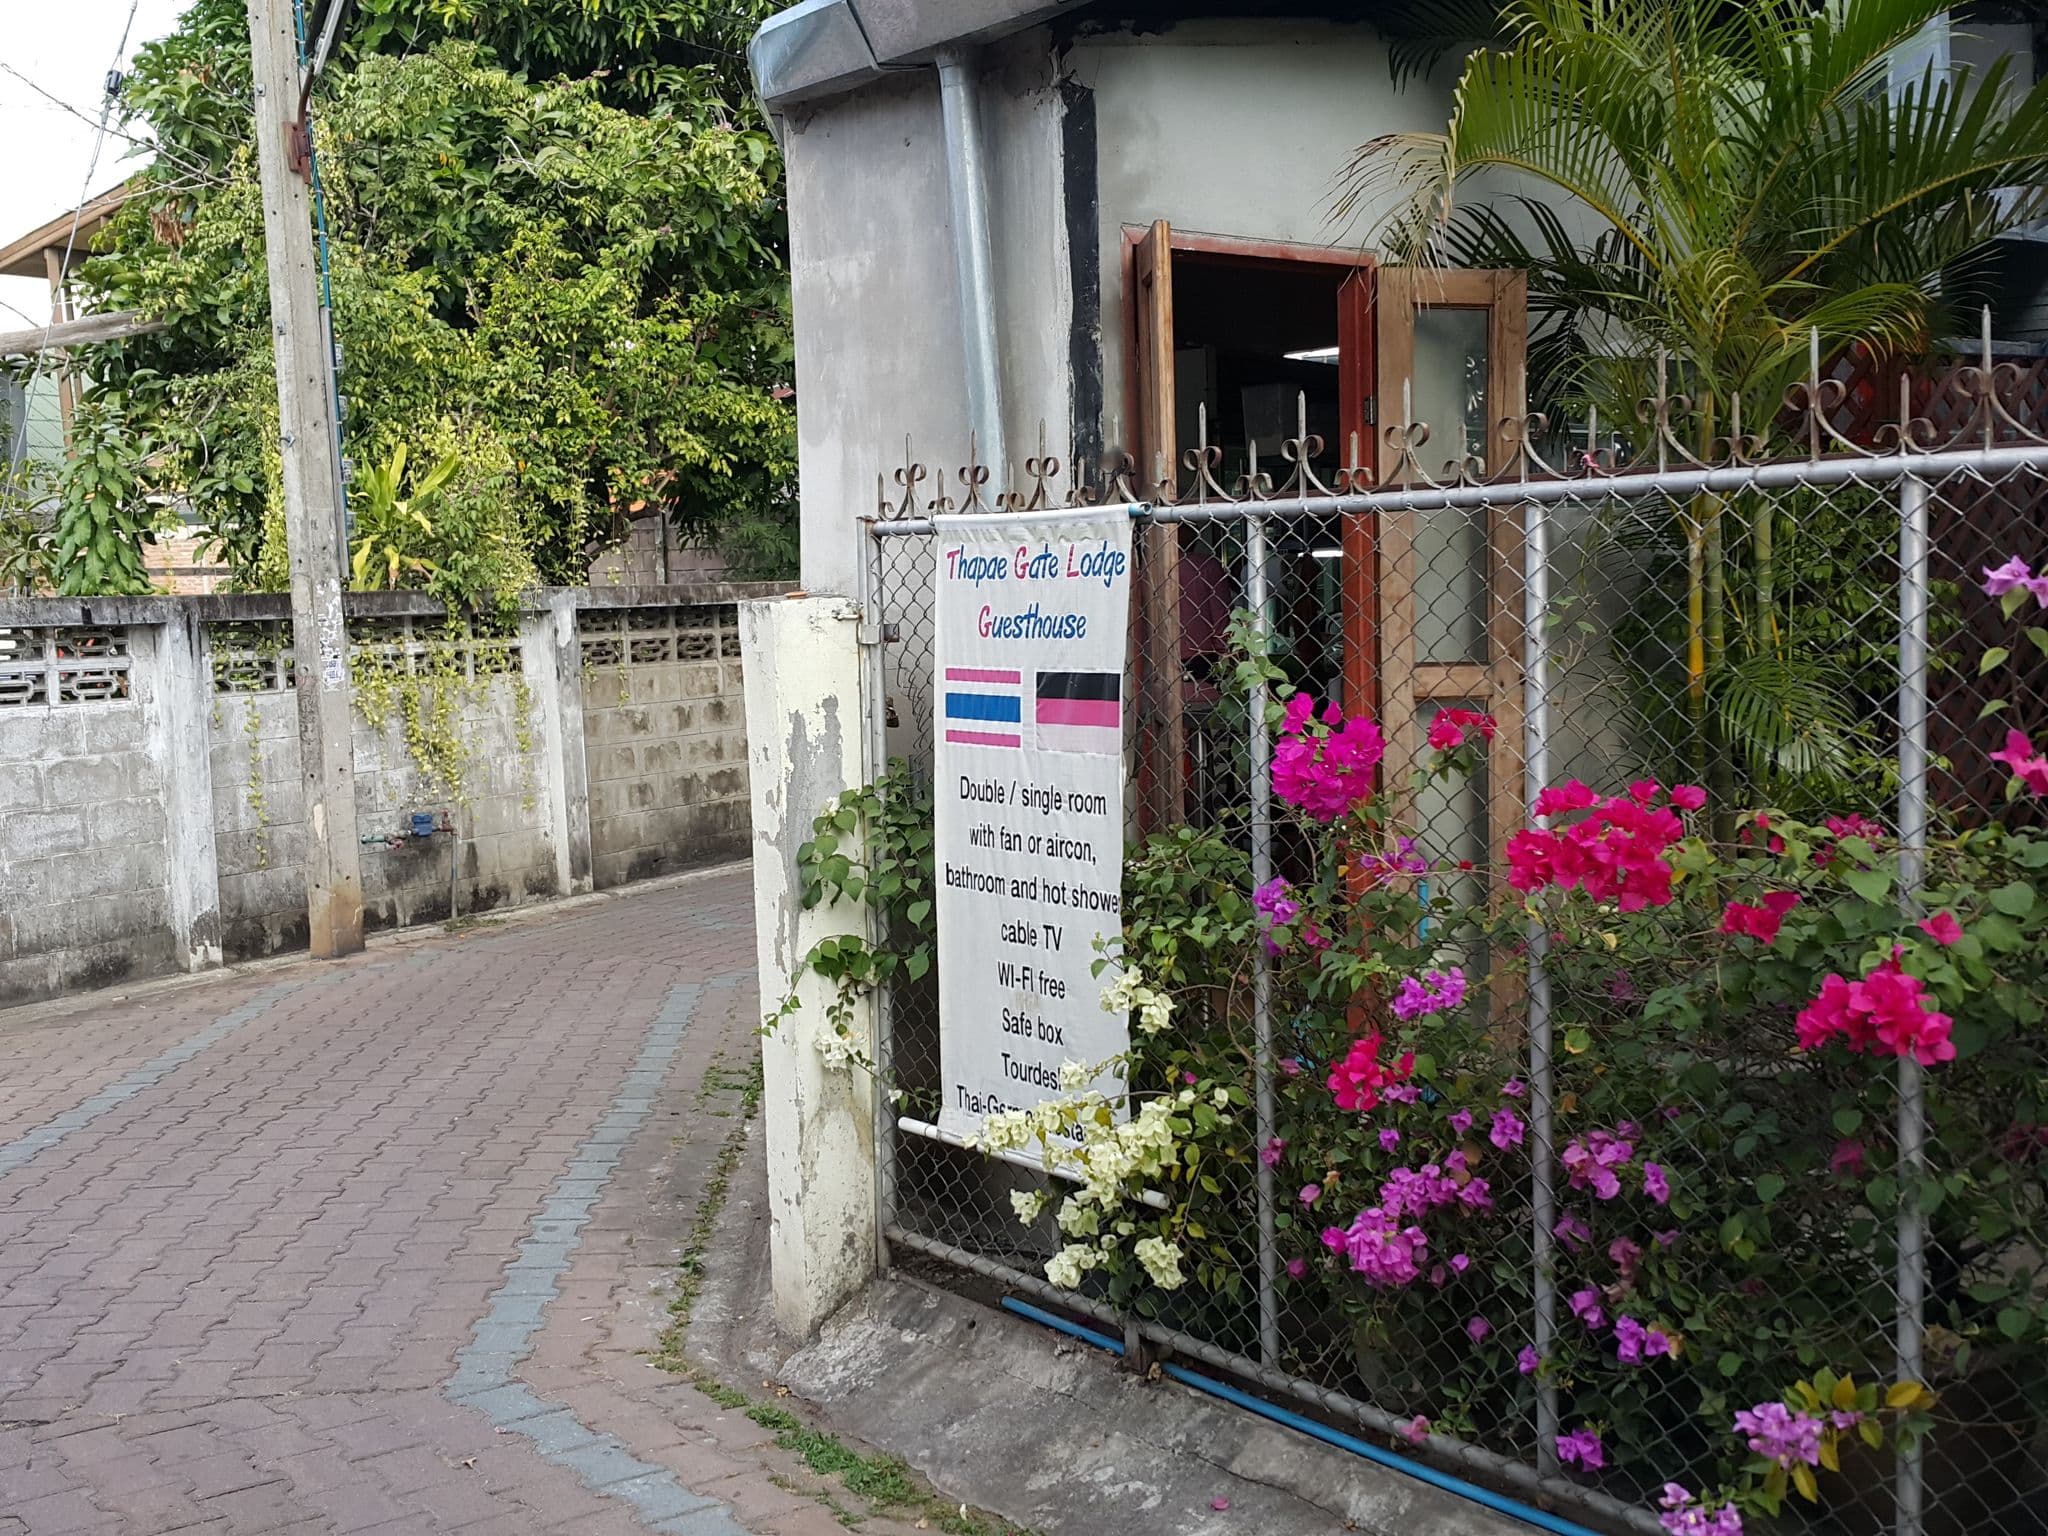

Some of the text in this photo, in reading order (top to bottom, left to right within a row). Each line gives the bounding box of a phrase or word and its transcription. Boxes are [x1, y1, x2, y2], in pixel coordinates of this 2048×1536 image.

[946, 541, 1125, 588] Thapae Gate Lodge
[978, 602, 1087, 639] Guesthouse
[961, 776, 1004, 803] Double
[1022, 783, 1062, 815] single
[1069, 794, 1106, 815] room
[970, 823, 1095, 865] with fan or aircon,
[946, 863, 1120, 913] bathroom and hot showe
[1002, 920, 1062, 951] cable TV
[998, 962, 1065, 999] WI-FI free
[1003, 1008, 1063, 1045] Safe box
